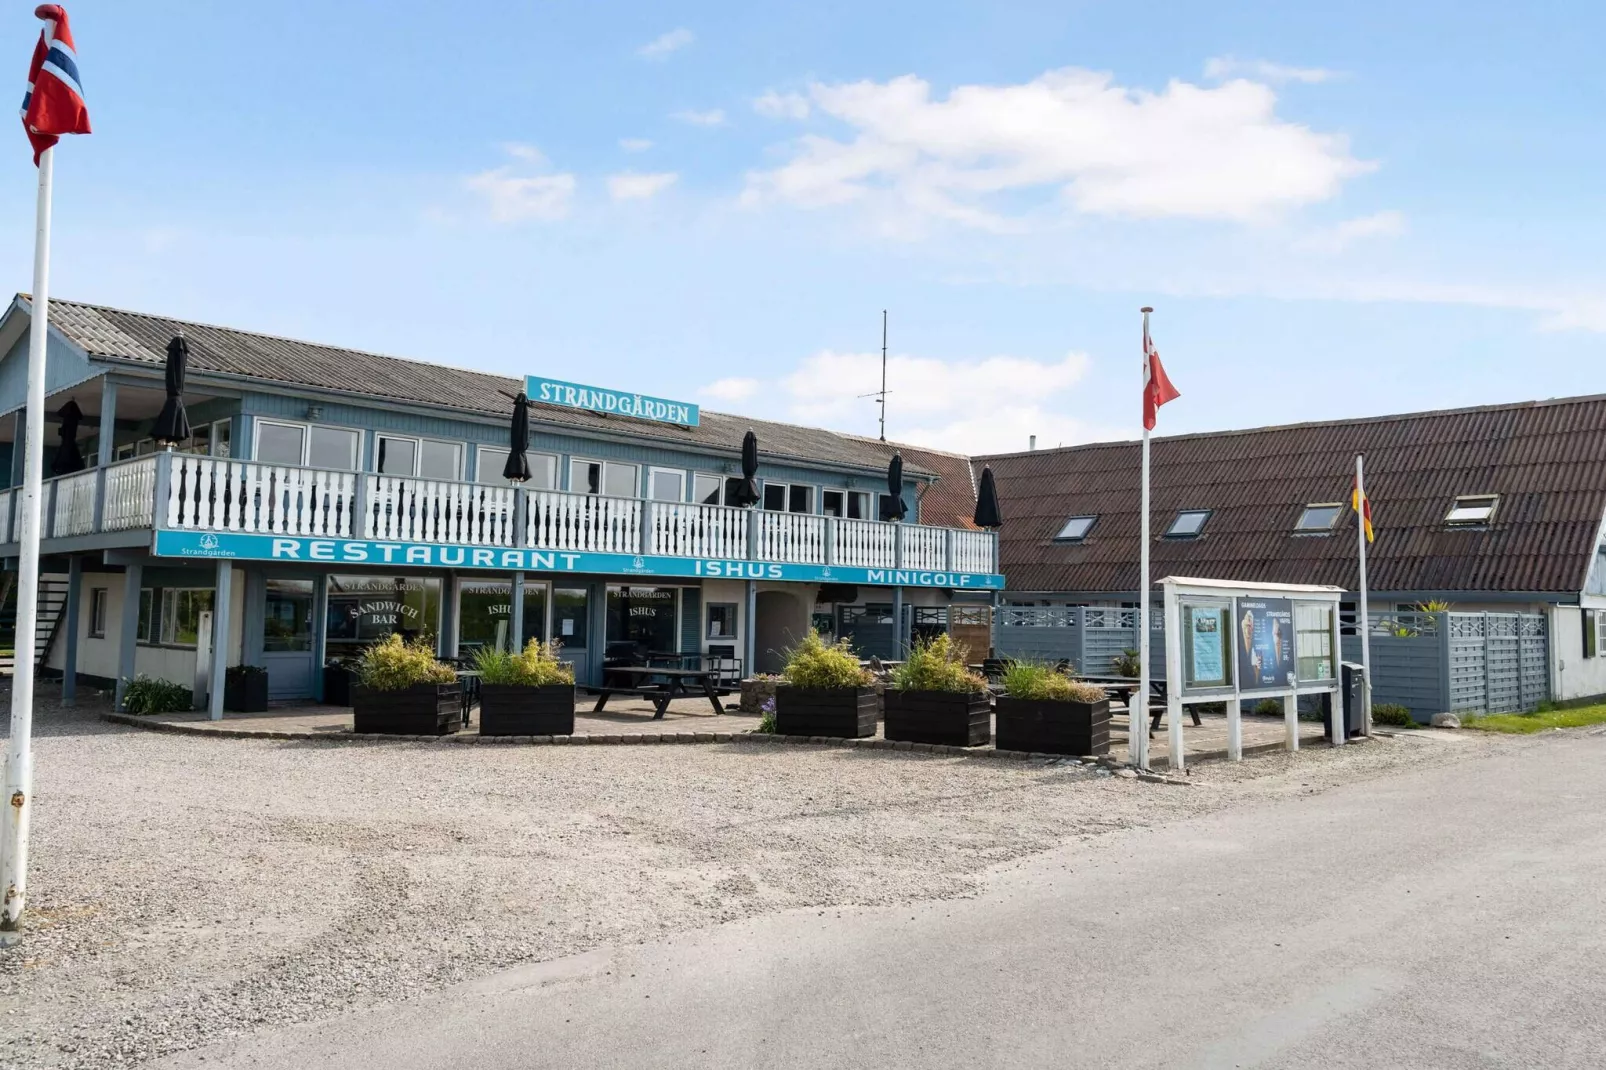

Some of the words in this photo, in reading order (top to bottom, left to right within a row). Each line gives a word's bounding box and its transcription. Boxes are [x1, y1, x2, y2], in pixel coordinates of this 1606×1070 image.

[272, 538, 581, 570] RESTAURANT
[695, 560, 783, 578] ISHUS
[867, 569, 971, 586] MINIGOLF
[349, 600, 420, 619] SANDWICH
[629, 606, 657, 617] ISHUS
[372, 614, 397, 624] BAR
